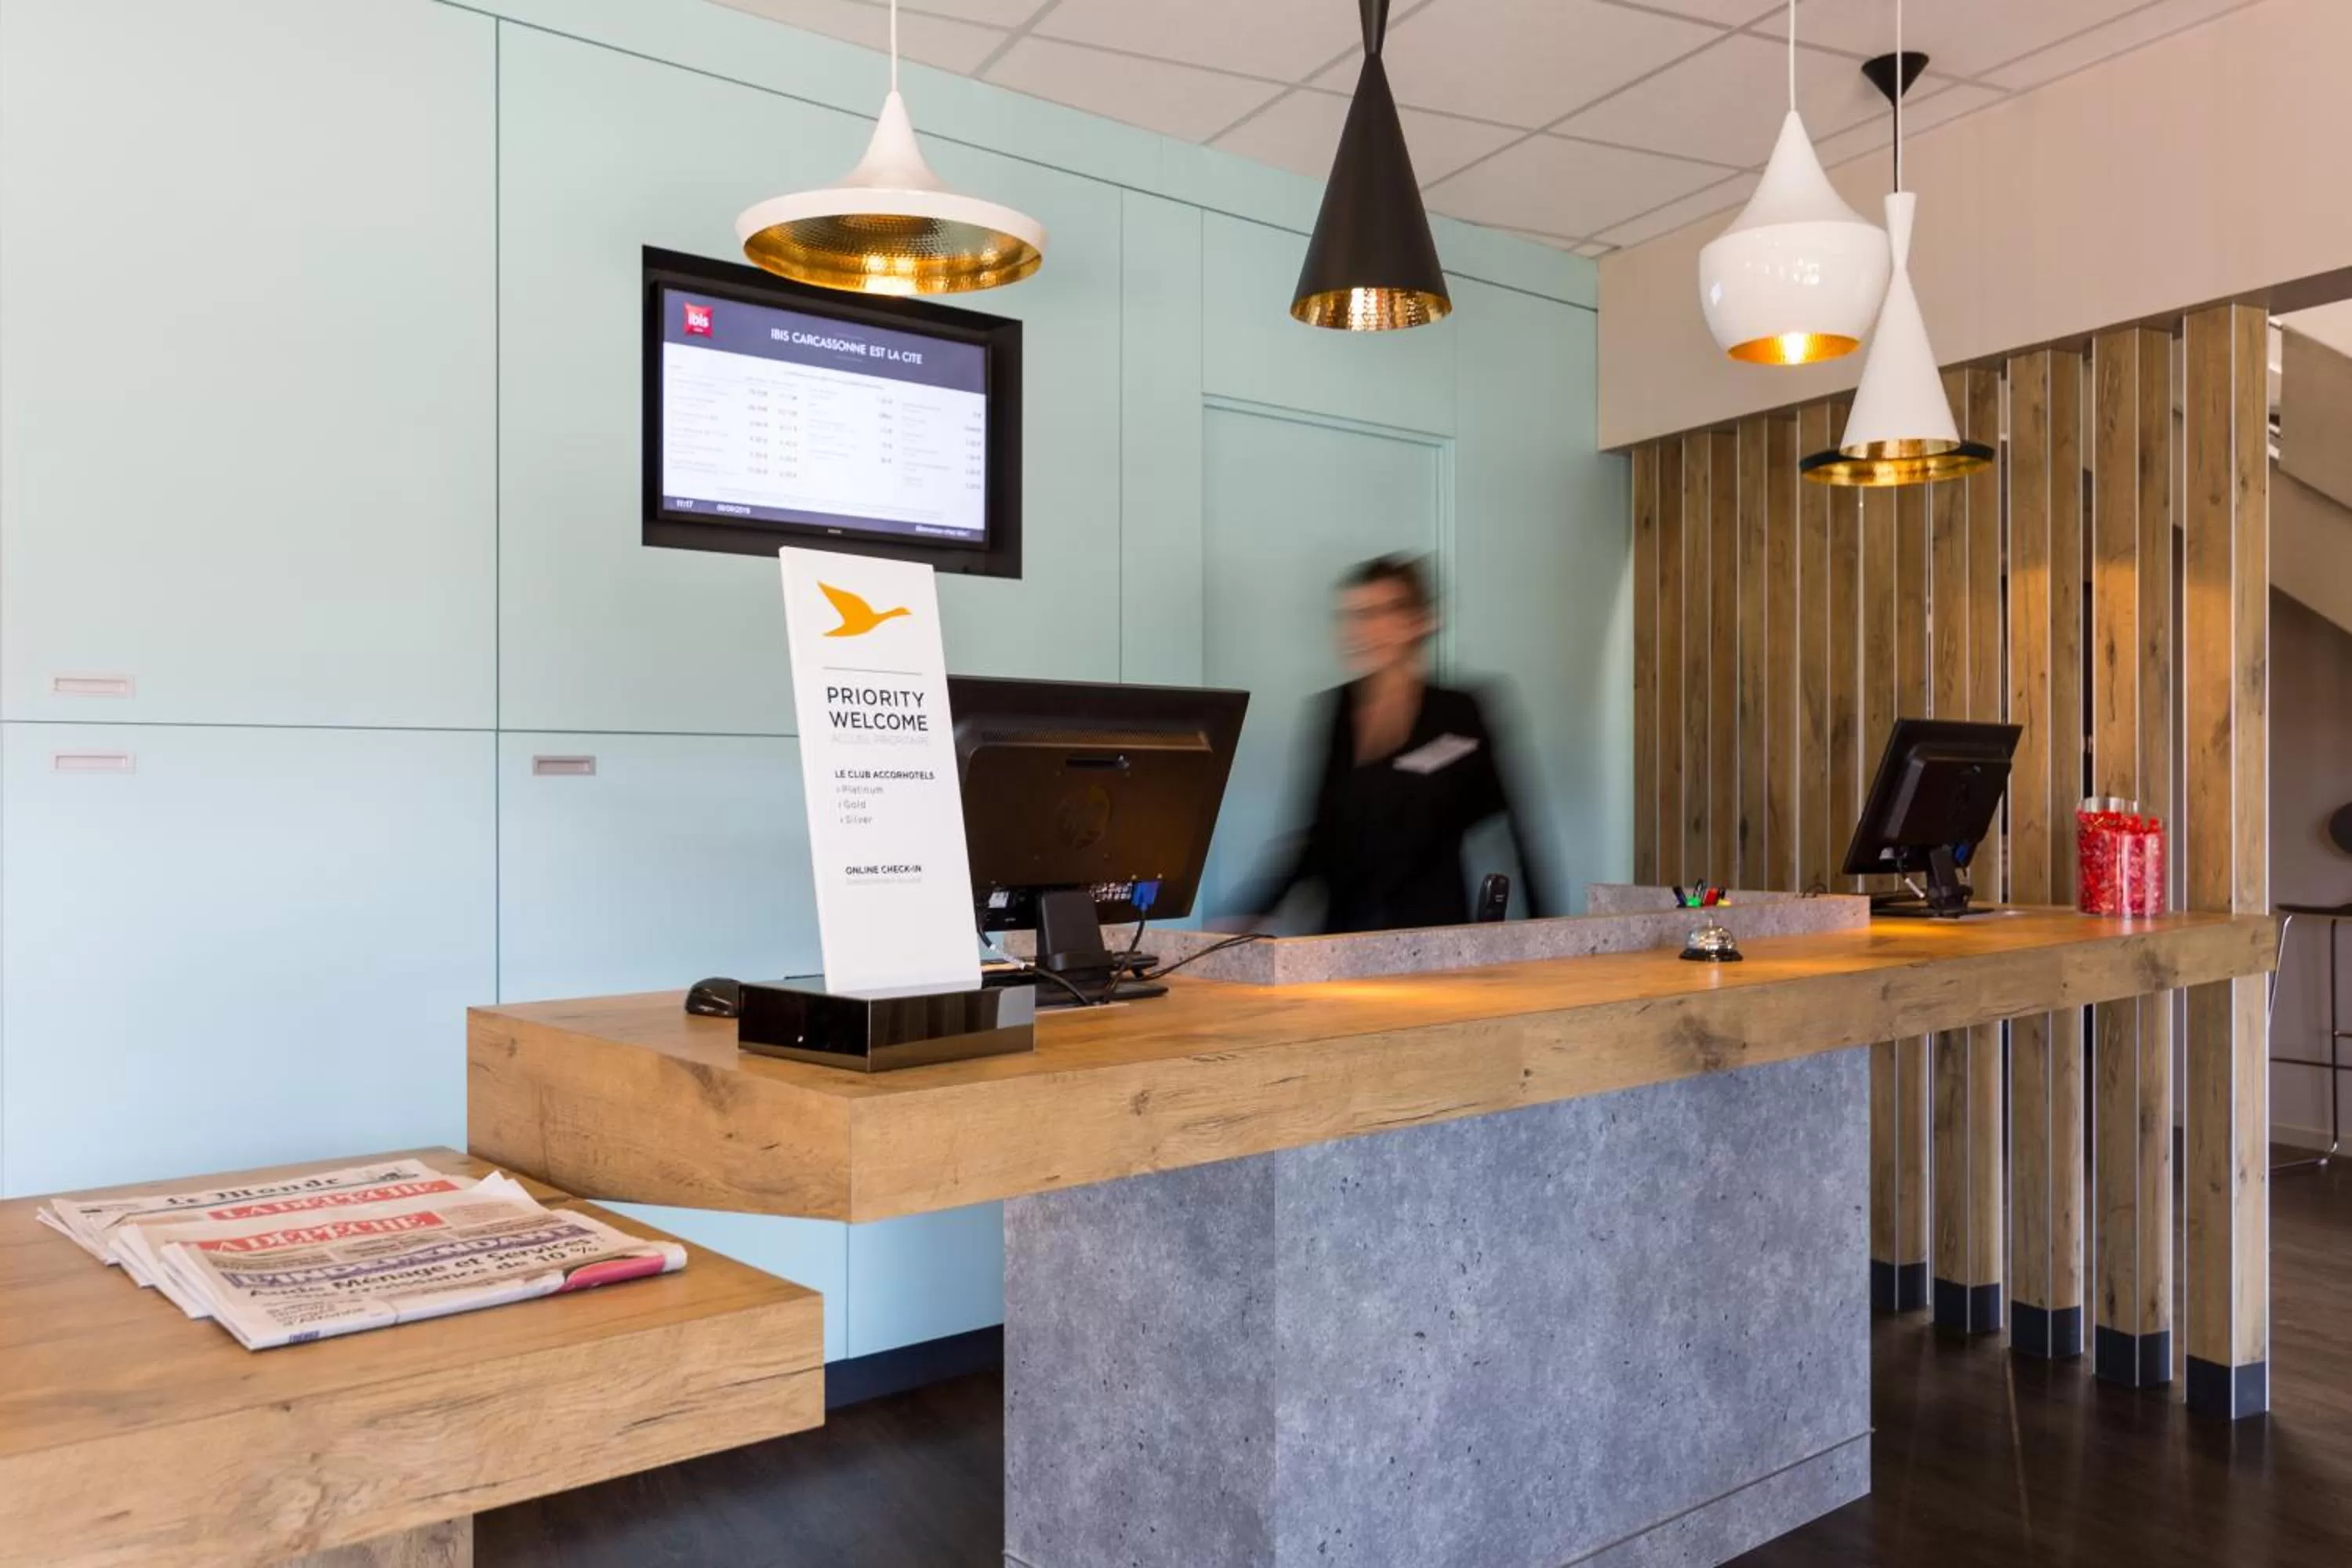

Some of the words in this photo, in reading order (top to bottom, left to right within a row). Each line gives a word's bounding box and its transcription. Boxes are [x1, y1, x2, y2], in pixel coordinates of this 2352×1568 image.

[687, 312, 710, 328] ibis
[771, 328, 789, 342] IBIS
[792, 332, 866, 355] CARCASSONNE
[869, 345, 886, 358] EST
[887, 349, 900, 361] LA
[902, 351, 924, 365] CITE
[827, 686, 924, 708] PRIORITY
[829, 710, 928, 731] WELCOME
[835, 769, 845, 779] LE
[848, 770, 871, 779] CLUB
[873, 771, 935, 780] ACCORHOTELS
[841, 785, 884, 794] Platinum
[843, 800, 866, 808] Gold
[846, 815, 872, 824] Silver
[846, 866, 879, 875] ONLINE
[880, 865, 921, 873] CHECK-IN
[216, 1178, 339, 1200] Monde
[454, 1258, 485, 1269] et
[486, 1239, 592, 1261] Services
